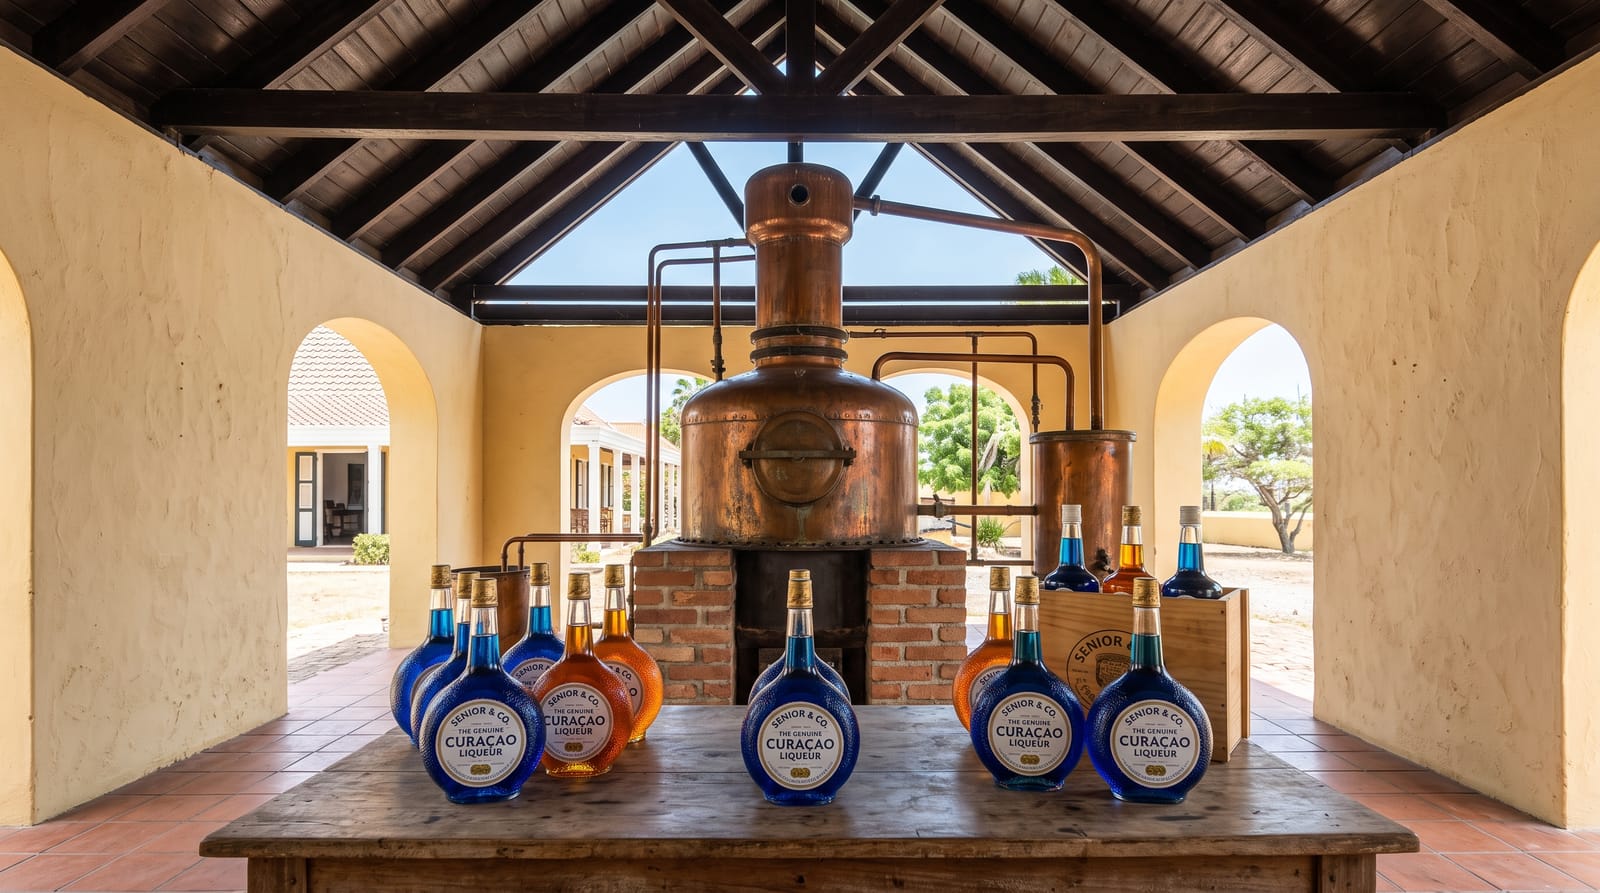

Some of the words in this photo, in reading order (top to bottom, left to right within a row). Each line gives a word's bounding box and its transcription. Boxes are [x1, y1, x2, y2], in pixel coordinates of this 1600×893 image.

[1075, 636, 1122, 663] SENIOR
[516, 664, 544, 678] SENIOR
[548, 690, 578, 707] SENIOR
[588, 695, 599, 707] CO.
[1001, 700, 1034, 717] SENIOR
[1044, 706, 1056, 719] CO.
[451, 707, 486, 726] SENIOR
[497, 712, 510, 725] CO.
[544, 716, 605, 727] CURAÇAO
[772, 710, 805, 728] SENIOR
[816, 716, 828, 728] CO.
[1125, 707, 1159, 726] SENIOR
[1170, 714, 1183, 727] CO.
[996, 726, 1063, 740] CURAÇAO
[446, 735, 517, 748] CURAÇAO
[766, 739, 834, 751] CURAÇAO
[1009, 739, 1050, 748] LIQUEUR
[1120, 736, 1190, 749] CURAÇAO
[460, 748, 502, 758] LIQUEUR
[780, 752, 821, 761] LIQUEUR
[1134, 749, 1177, 758] LIQUEUR
